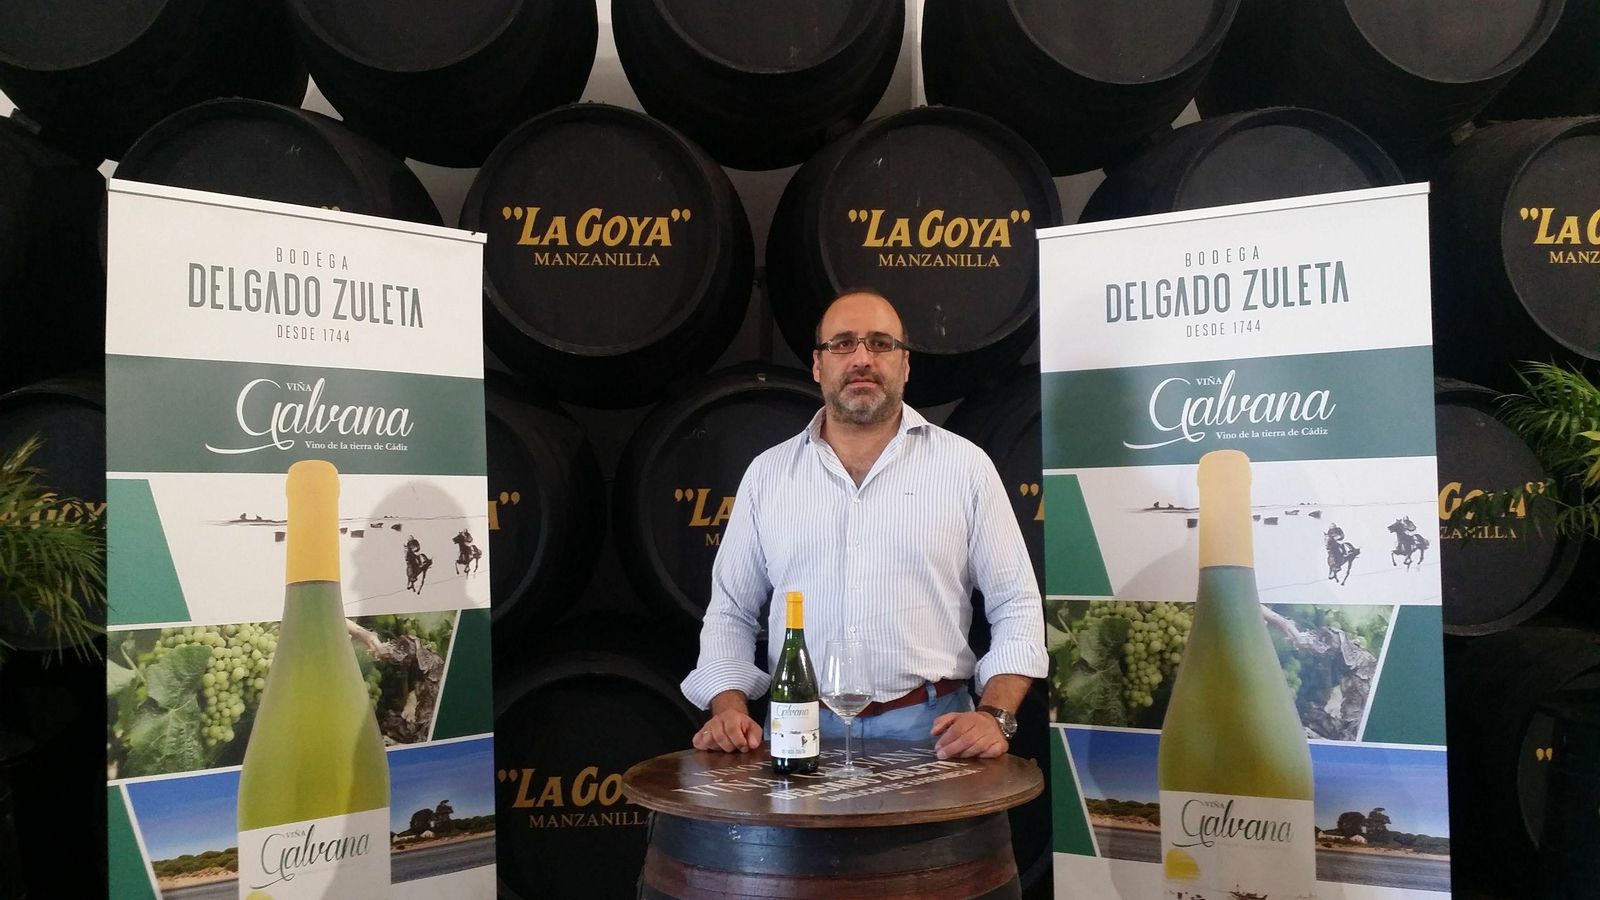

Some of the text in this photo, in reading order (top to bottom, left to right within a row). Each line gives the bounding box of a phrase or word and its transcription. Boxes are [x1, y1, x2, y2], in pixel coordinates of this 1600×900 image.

[276, 246, 349, 271] BODEGA
[534, 252, 661, 266] MANZANILLA
[879, 253, 1001, 267] MANZANILLA
[1185, 245, 1260, 268] BODEGA
[188, 262, 424, 329] DELGADO ZULETA
[1105, 260, 1350, 323] DELGADO ZULETA
[277, 324, 350, 344] DESDE 1744
[1186, 319, 1261, 338] DESDE 1744
[286, 381, 312, 392] VIÑA
[1196, 375, 1223, 386] VIÑA
[205, 377, 415, 454] Galvana
[1122, 369, 1337, 450] Galvana
[1216, 427, 1329, 440] Vino de la tierra de Cádiz
[304, 440, 409, 451] Vino de la tierra de Cádiz
[1171, 799, 1295, 848] Galvana
[251, 823, 370, 890] Galvana
